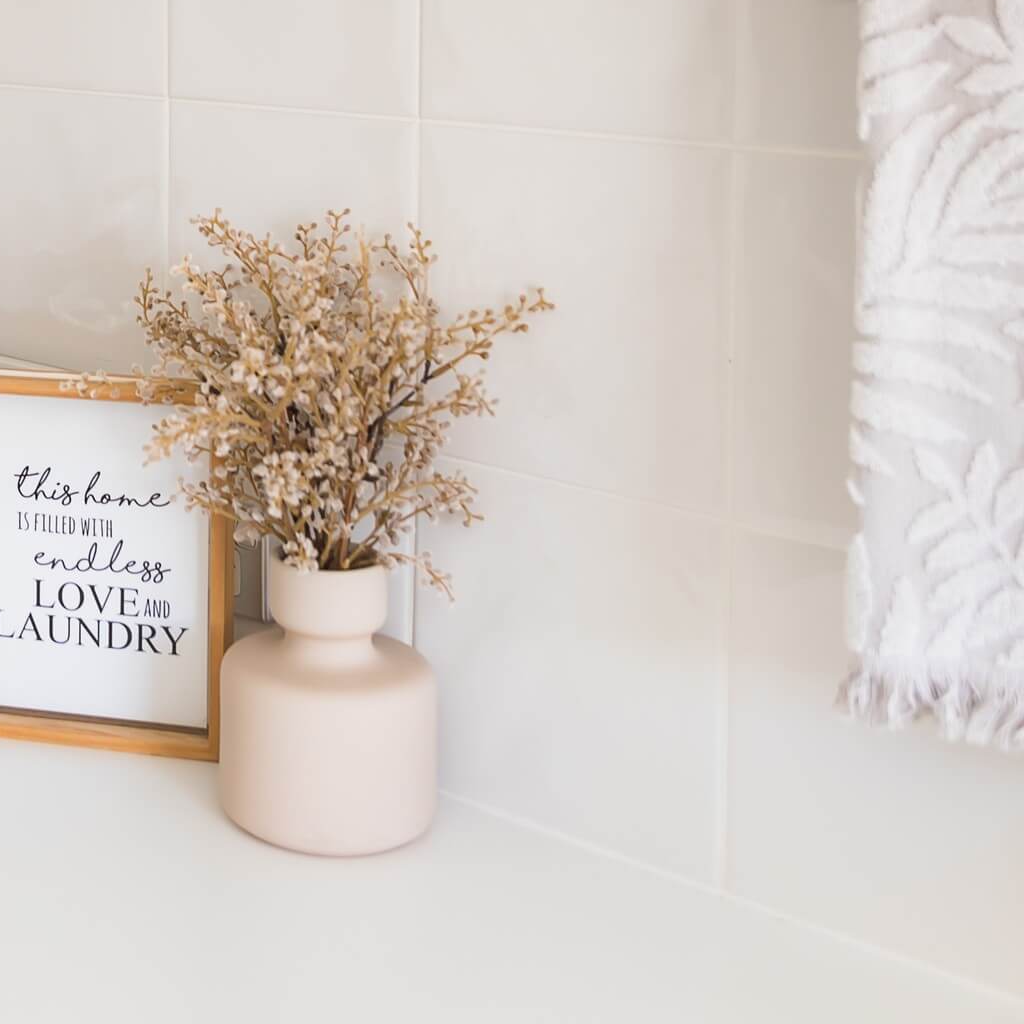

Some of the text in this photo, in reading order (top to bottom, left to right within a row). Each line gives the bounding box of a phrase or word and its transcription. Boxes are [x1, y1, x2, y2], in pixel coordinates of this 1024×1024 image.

[14, 465, 170, 507] this home
[17, 511, 113, 538] IS FILLED WITH
[33, 539, 172, 584] endless
[33, 578, 170, 619] LOVE AND
